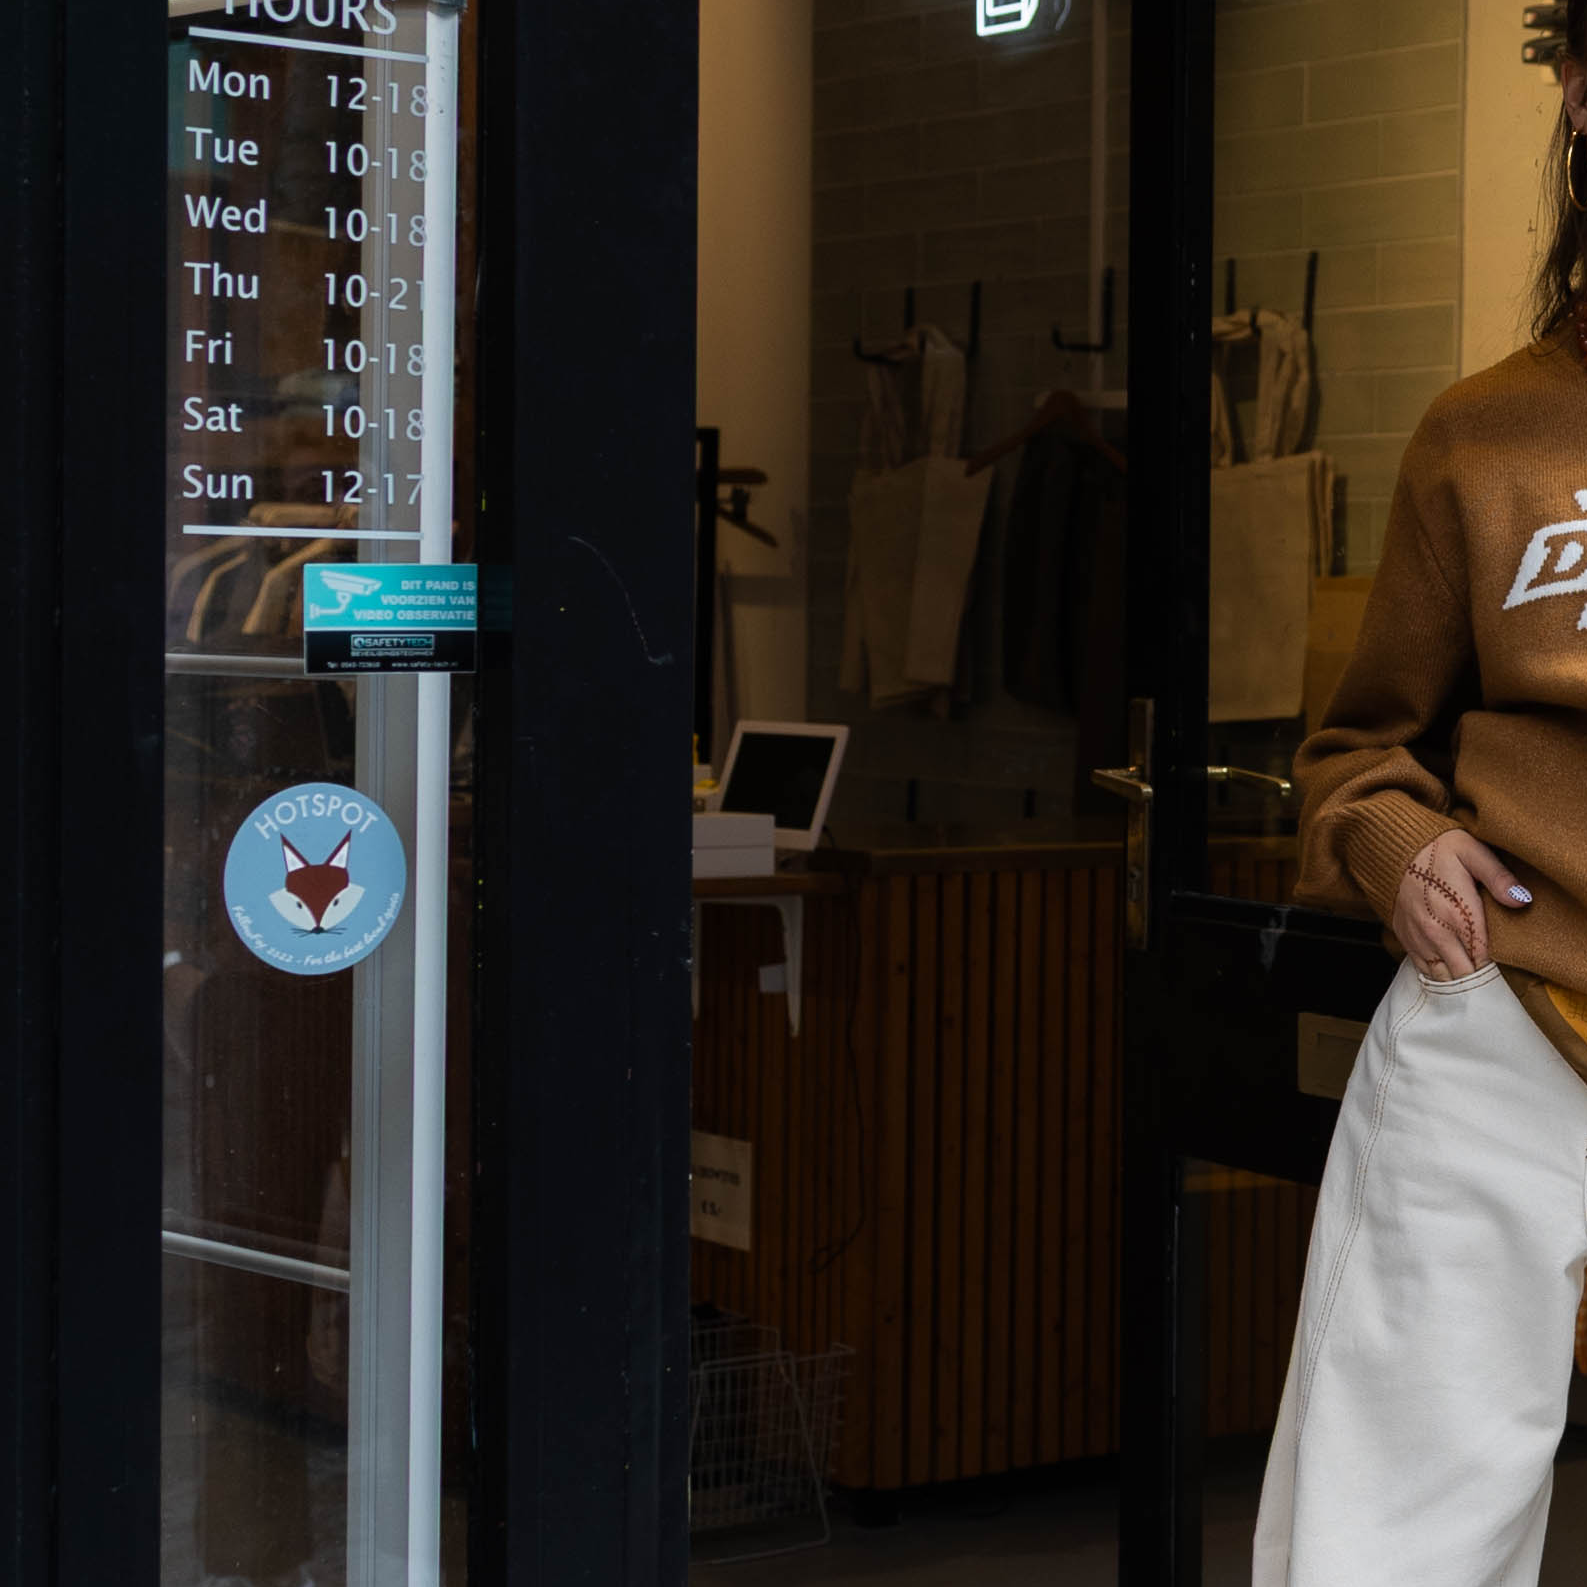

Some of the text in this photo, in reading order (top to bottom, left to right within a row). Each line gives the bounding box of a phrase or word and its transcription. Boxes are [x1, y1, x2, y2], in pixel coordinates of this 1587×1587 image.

[188, 59, 428, 117] Mon 12-18
[185, 127, 427, 182] Tue 10-18
[184, 194, 427, 247] Wed 10-18
[184, 262, 425, 311] Thu 10-21
[185, 330, 425, 376] Fri 10-18
[183, 396, 425, 441] Sat 10-18
[182, 464, 425, 506] Sun 12-17
[381, 594, 475, 606] VOORZIEN VAN
[401, 580, 475, 591] DIT PAND IS
[353, 609, 475, 621] VIDEO OBSERVATIE
[254, 793, 379, 840] HOTSPOT
[324, 950, 343, 965] the
